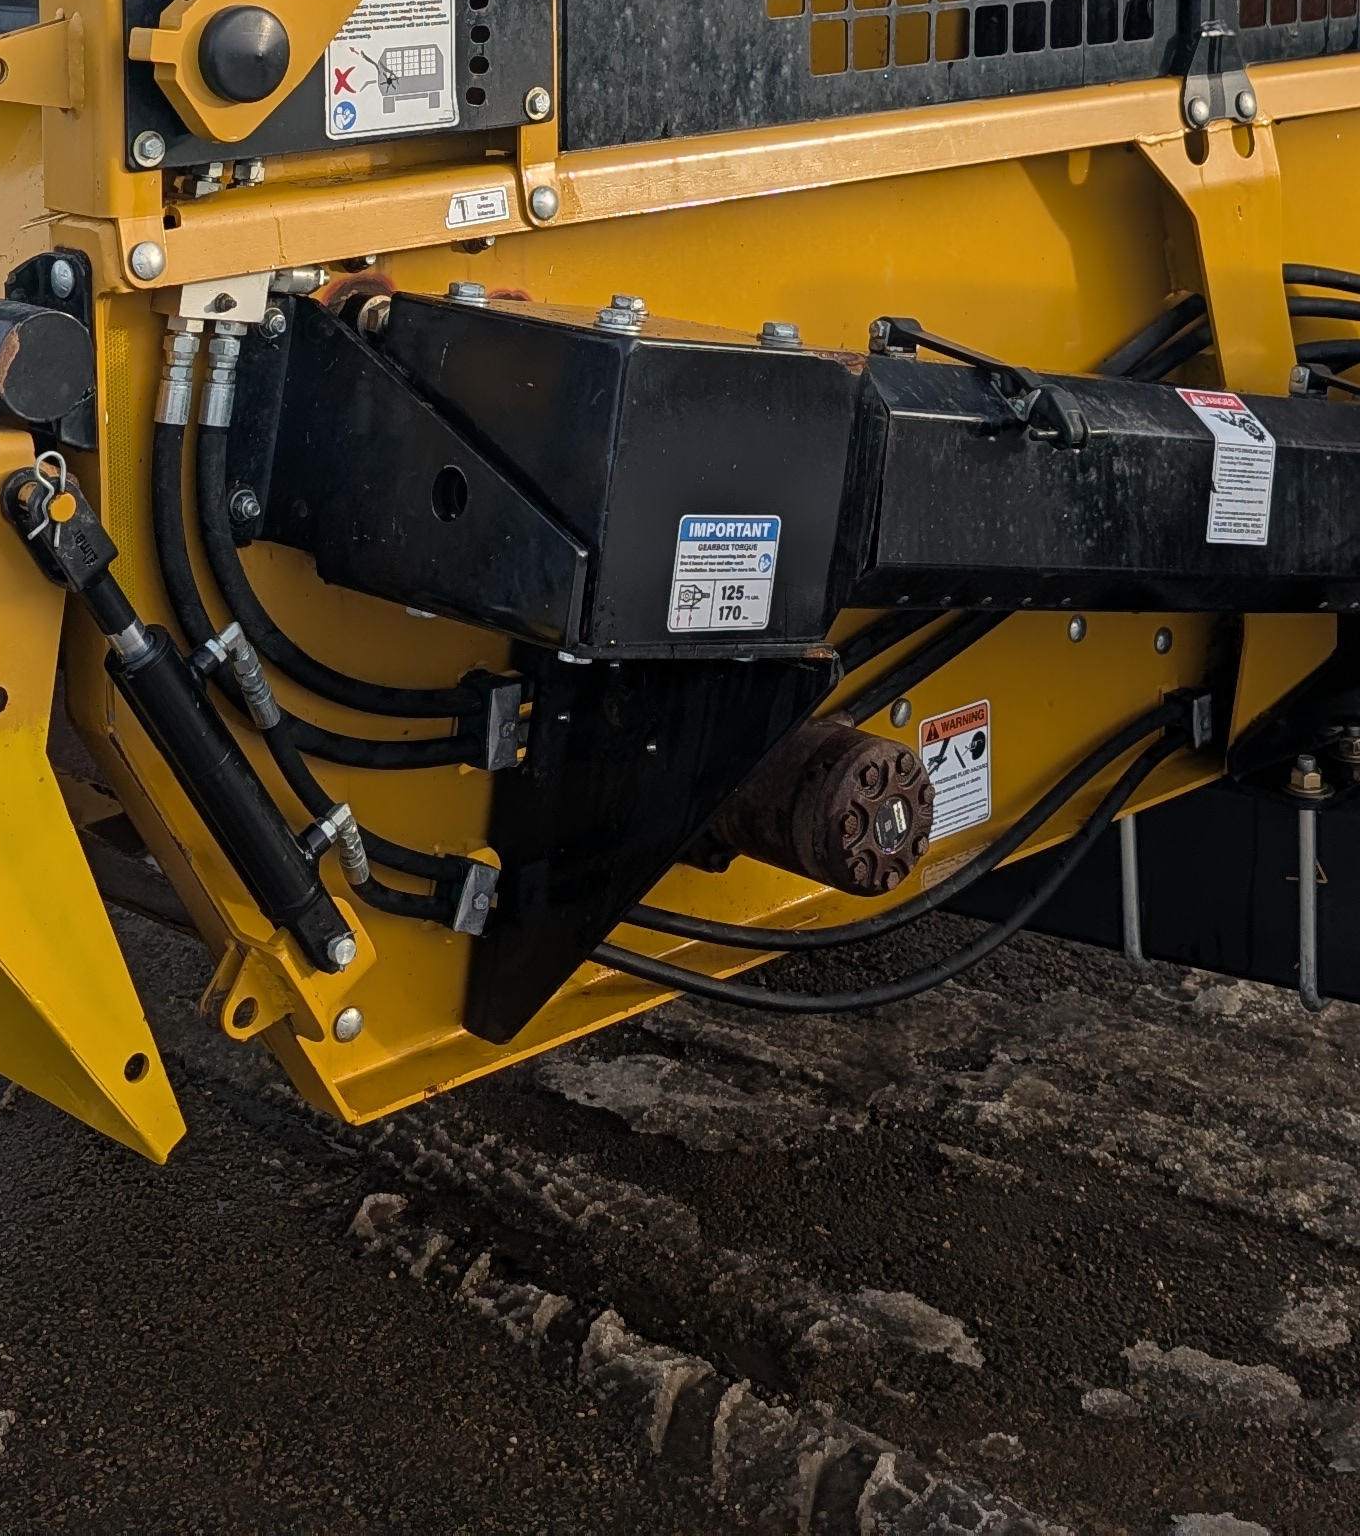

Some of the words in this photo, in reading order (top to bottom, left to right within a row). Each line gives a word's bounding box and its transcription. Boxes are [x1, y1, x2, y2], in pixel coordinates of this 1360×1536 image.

[1202, 395, 1239, 407] DANGER
[688, 522, 772, 538] IMPORTANT
[697, 543, 730, 551] GEARBOX
[731, 543, 758, 551] TORQUE
[721, 584, 745, 601] 125
[718, 605, 742, 621] 170
[940, 709, 985, 733] WARNING
